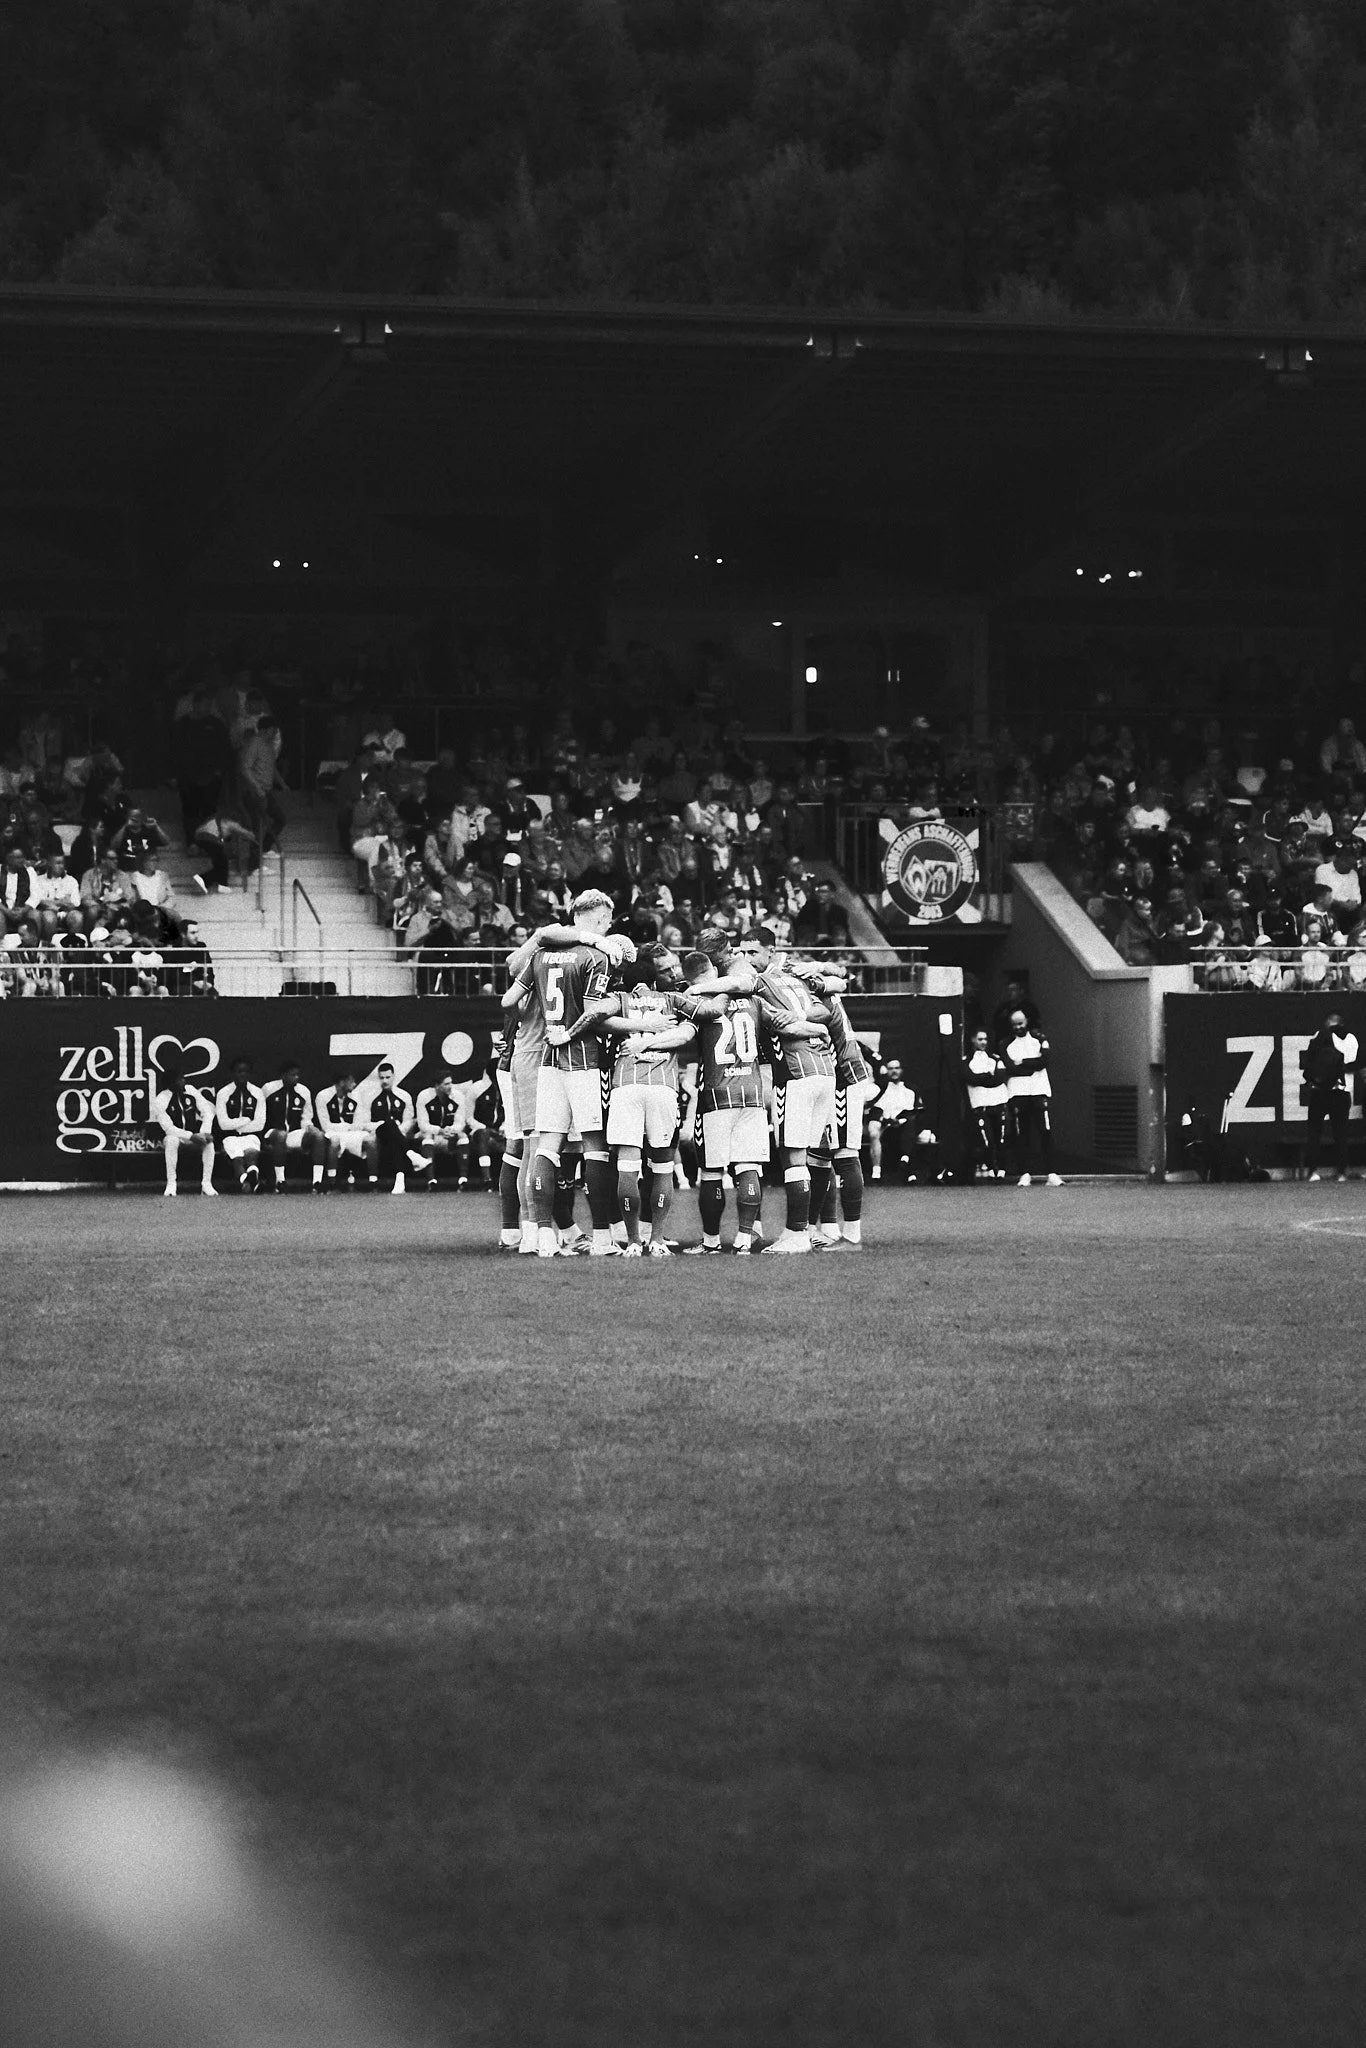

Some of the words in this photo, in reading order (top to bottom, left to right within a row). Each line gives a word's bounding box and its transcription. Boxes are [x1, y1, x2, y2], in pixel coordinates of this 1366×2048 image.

[545, 968, 565, 1021] 5
[59, 1026, 147, 1081] zell
[713, 1012, 759, 1065] 20
